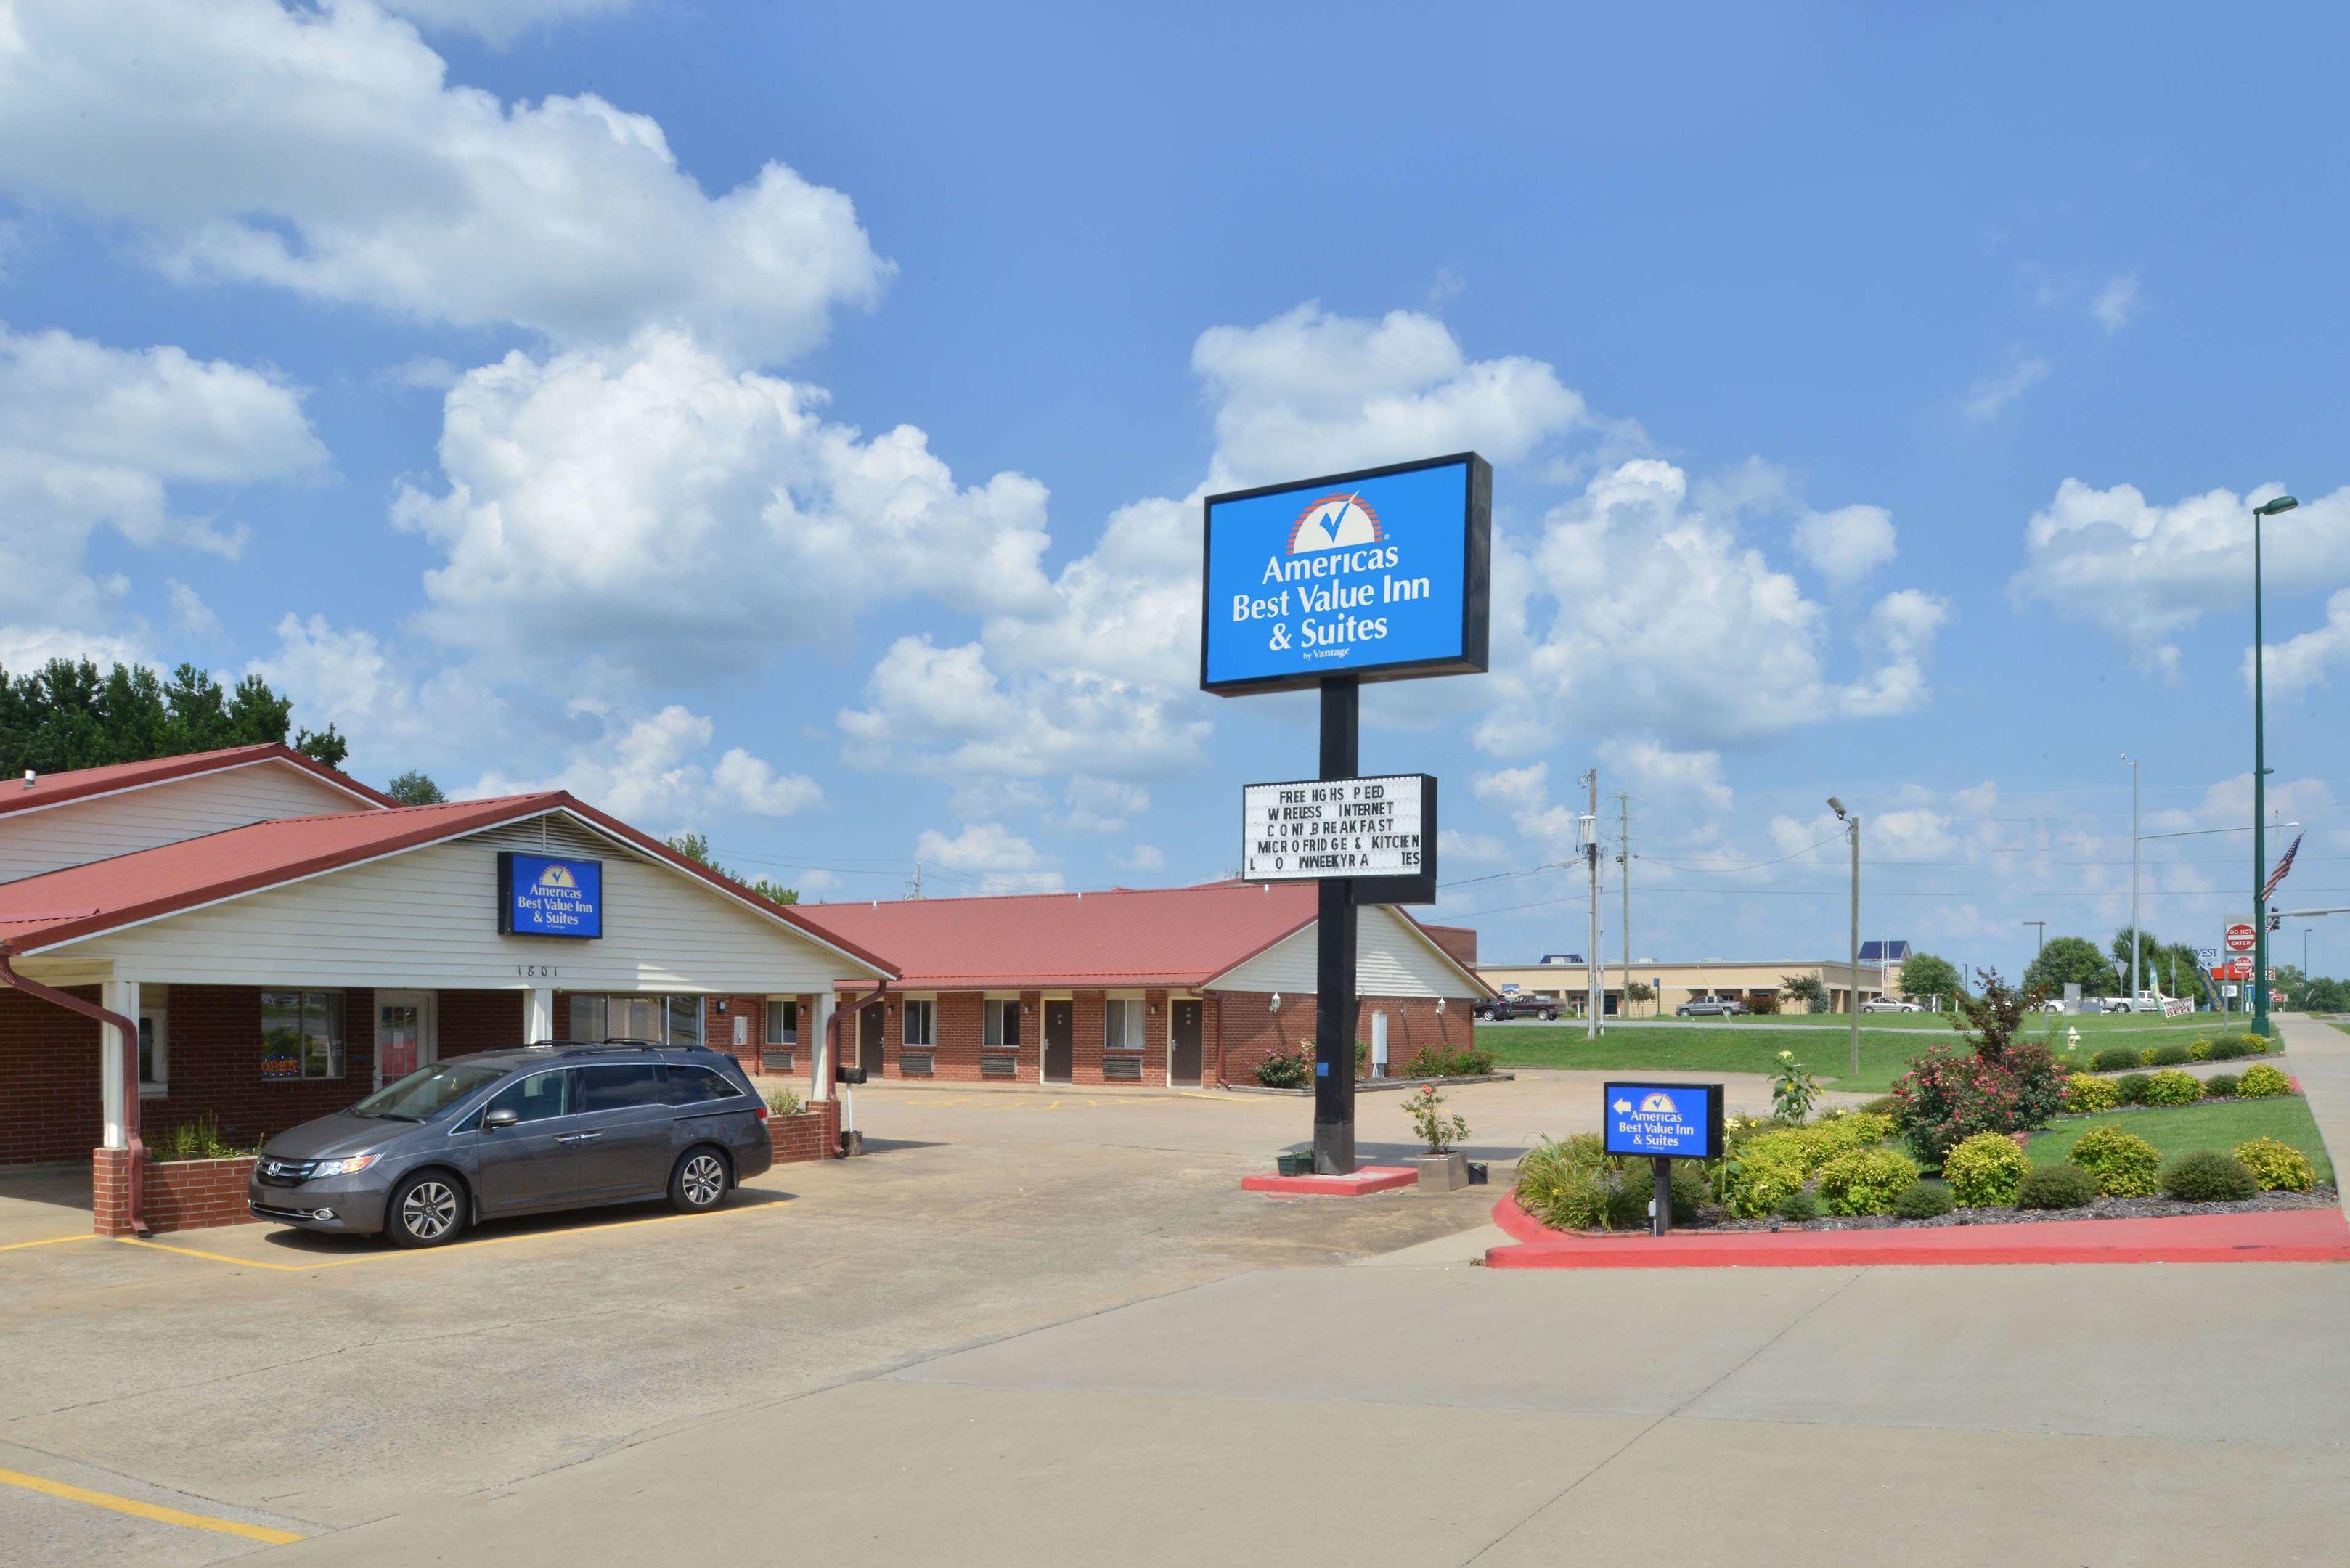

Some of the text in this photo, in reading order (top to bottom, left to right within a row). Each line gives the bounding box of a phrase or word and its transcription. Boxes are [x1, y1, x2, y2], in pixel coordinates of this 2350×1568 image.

[1262, 545, 1399, 585] Americas
[1233, 574, 1430, 622] Best Value Inn
[1268, 613, 1388, 651] & Suites
[1303, 647, 1350, 661] by Vantage
[1279, 790, 1306, 804] FREE
[1339, 801, 1394, 817] INTERNET
[1354, 836, 1363, 850] &
[1371, 835, 1420, 850] KITCHEN
[529, 883, 582, 899] Americas
[518, 896, 593, 913] Best Value Inn
[533, 911, 579, 925] & Suites
[261, 1060, 298, 1072] OPEN
[1631, 1111, 1683, 1122] Americas
[1619, 1122, 1694, 1135] Best Value Inn
[1633, 1135, 1679, 1146] & Suites
